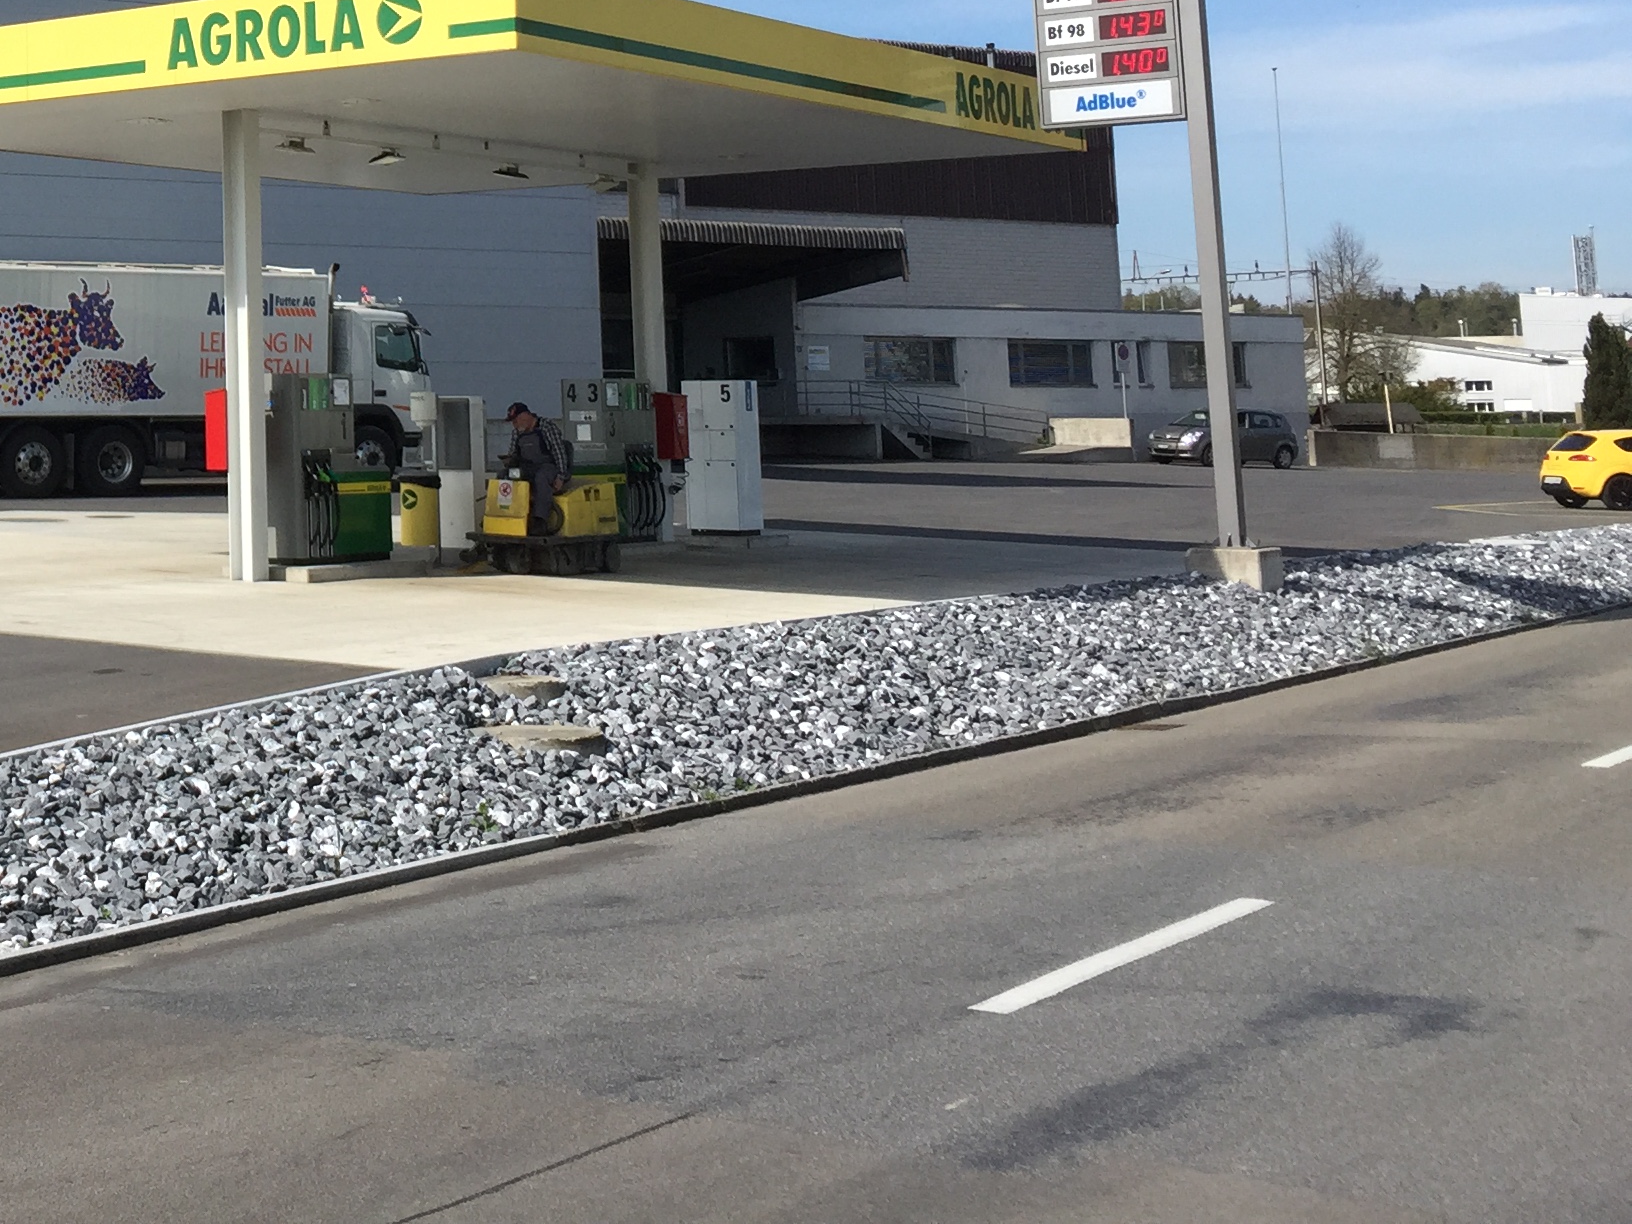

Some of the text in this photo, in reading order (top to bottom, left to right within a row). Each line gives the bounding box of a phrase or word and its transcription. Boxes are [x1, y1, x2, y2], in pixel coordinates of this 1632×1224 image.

[1048, 25, 1063, 40] Bf
[1067, 23, 1085, 38] 98
[1050, 57, 1094, 76] Diesel
[955, 71, 1036, 131] AGROLA
[275, 295, 300, 308] Futter
[303, 296, 316, 307] AG
[200, 332, 313, 353] LEING IN
[567, 383, 598, 403] 4 3
[720, 384, 731, 403] 5
